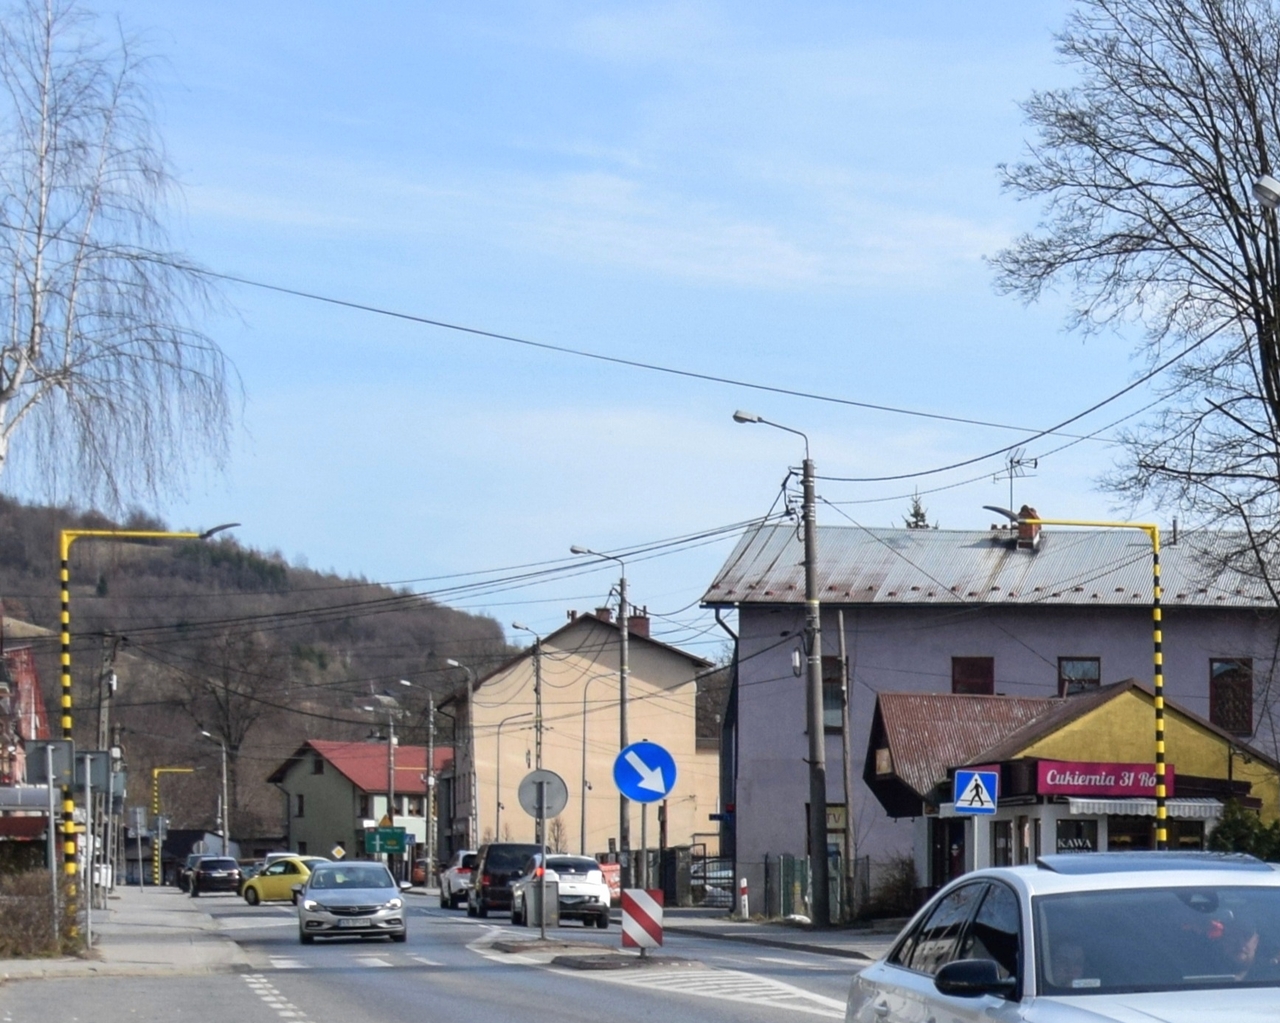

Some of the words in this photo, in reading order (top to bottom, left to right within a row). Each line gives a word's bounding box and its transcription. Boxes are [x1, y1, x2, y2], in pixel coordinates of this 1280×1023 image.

[1046, 769, 1115, 786] Cukiernia
[1119, 772, 1134, 787] 31
[1057, 838, 1092, 848] KAWA
